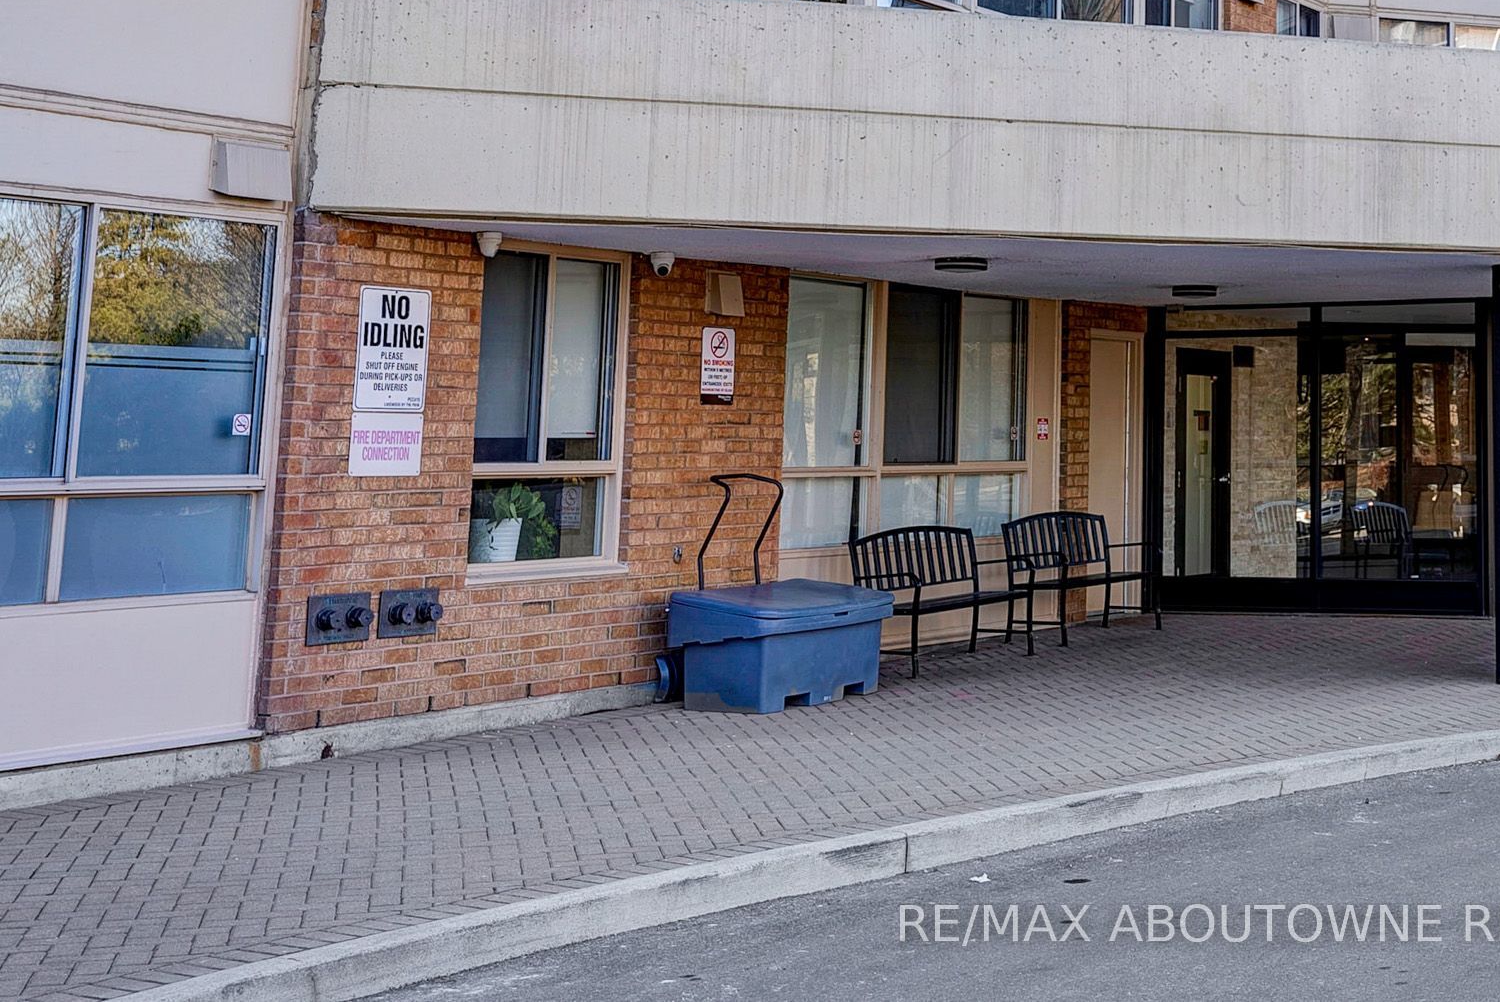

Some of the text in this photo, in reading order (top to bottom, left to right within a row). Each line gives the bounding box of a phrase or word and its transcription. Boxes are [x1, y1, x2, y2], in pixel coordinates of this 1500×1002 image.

[381, 294, 410, 320] NO
[363, 321, 425, 349] IDLING
[380, 351, 404, 361] PLEASE
[365, 361, 419, 372] SHUT OFF ENGINE
[359, 371, 423, 382] DURING PICK-UPS OR
[373, 382, 408, 392] DELIVERIES
[353, 430, 421, 445] FIRE DEPARTMENT
[362, 446, 410, 461] CONNECTION
